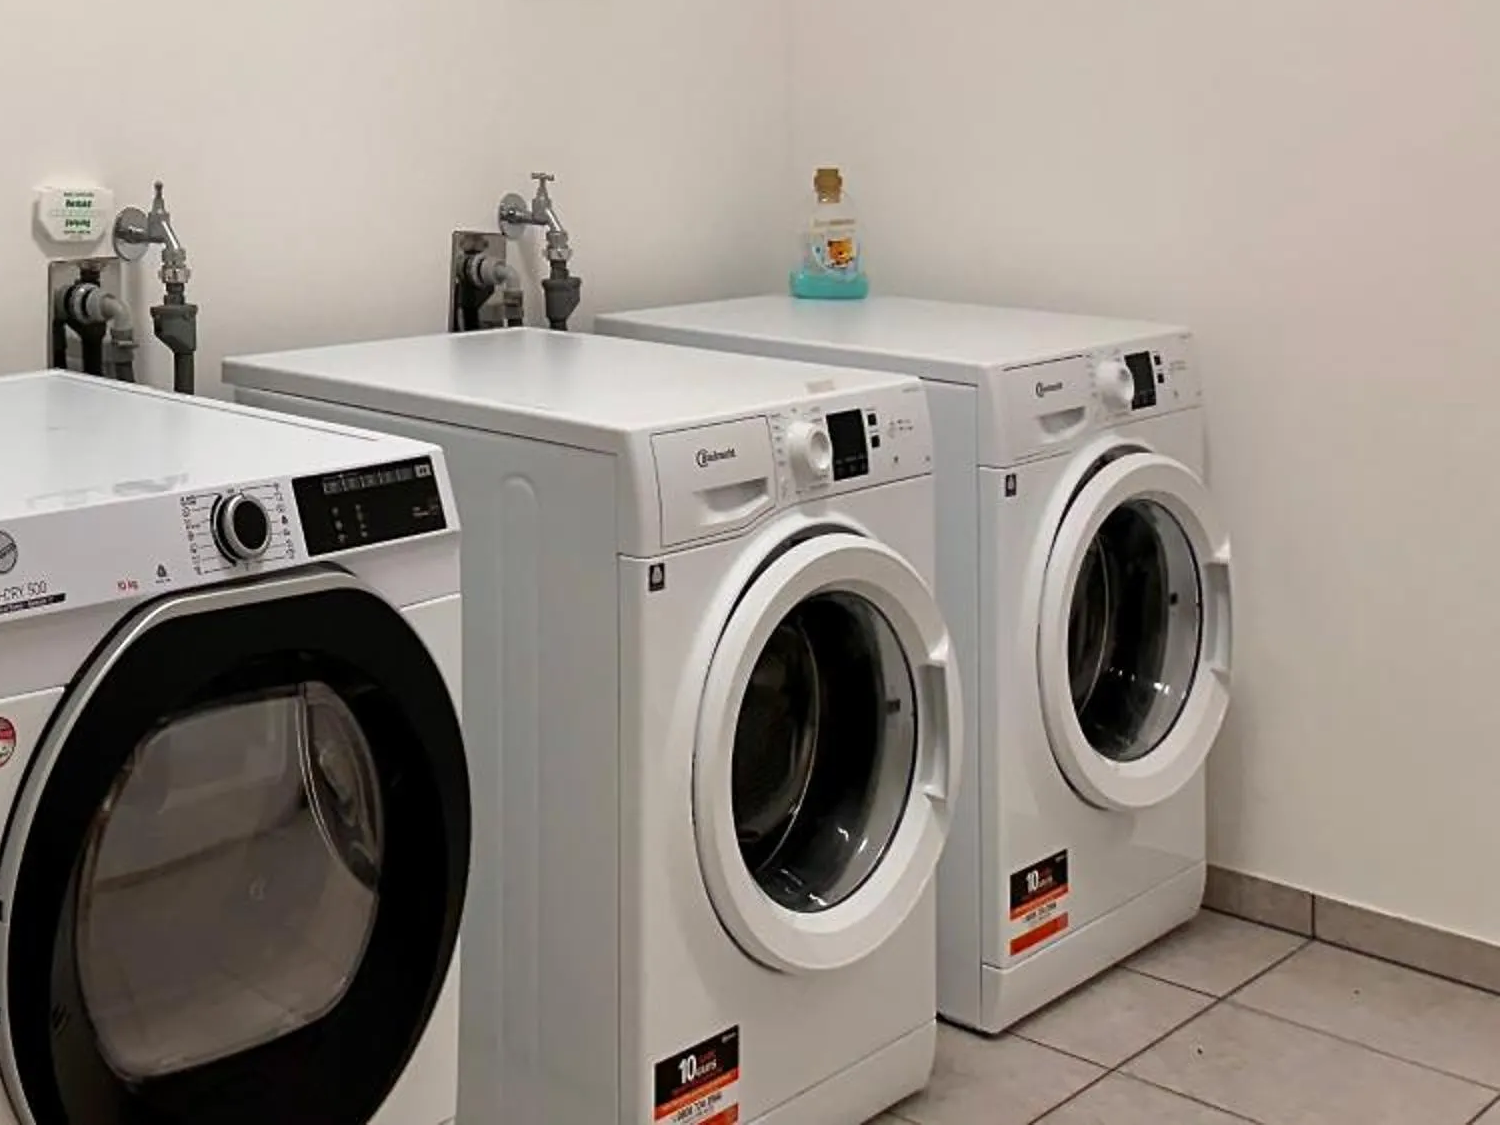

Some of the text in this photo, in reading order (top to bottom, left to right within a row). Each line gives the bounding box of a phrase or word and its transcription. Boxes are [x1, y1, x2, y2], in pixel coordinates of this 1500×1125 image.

[27, 580, 47, 595] 500
[1025, 870, 1039, 894] 10
[678, 1054, 697, 1084] 10
